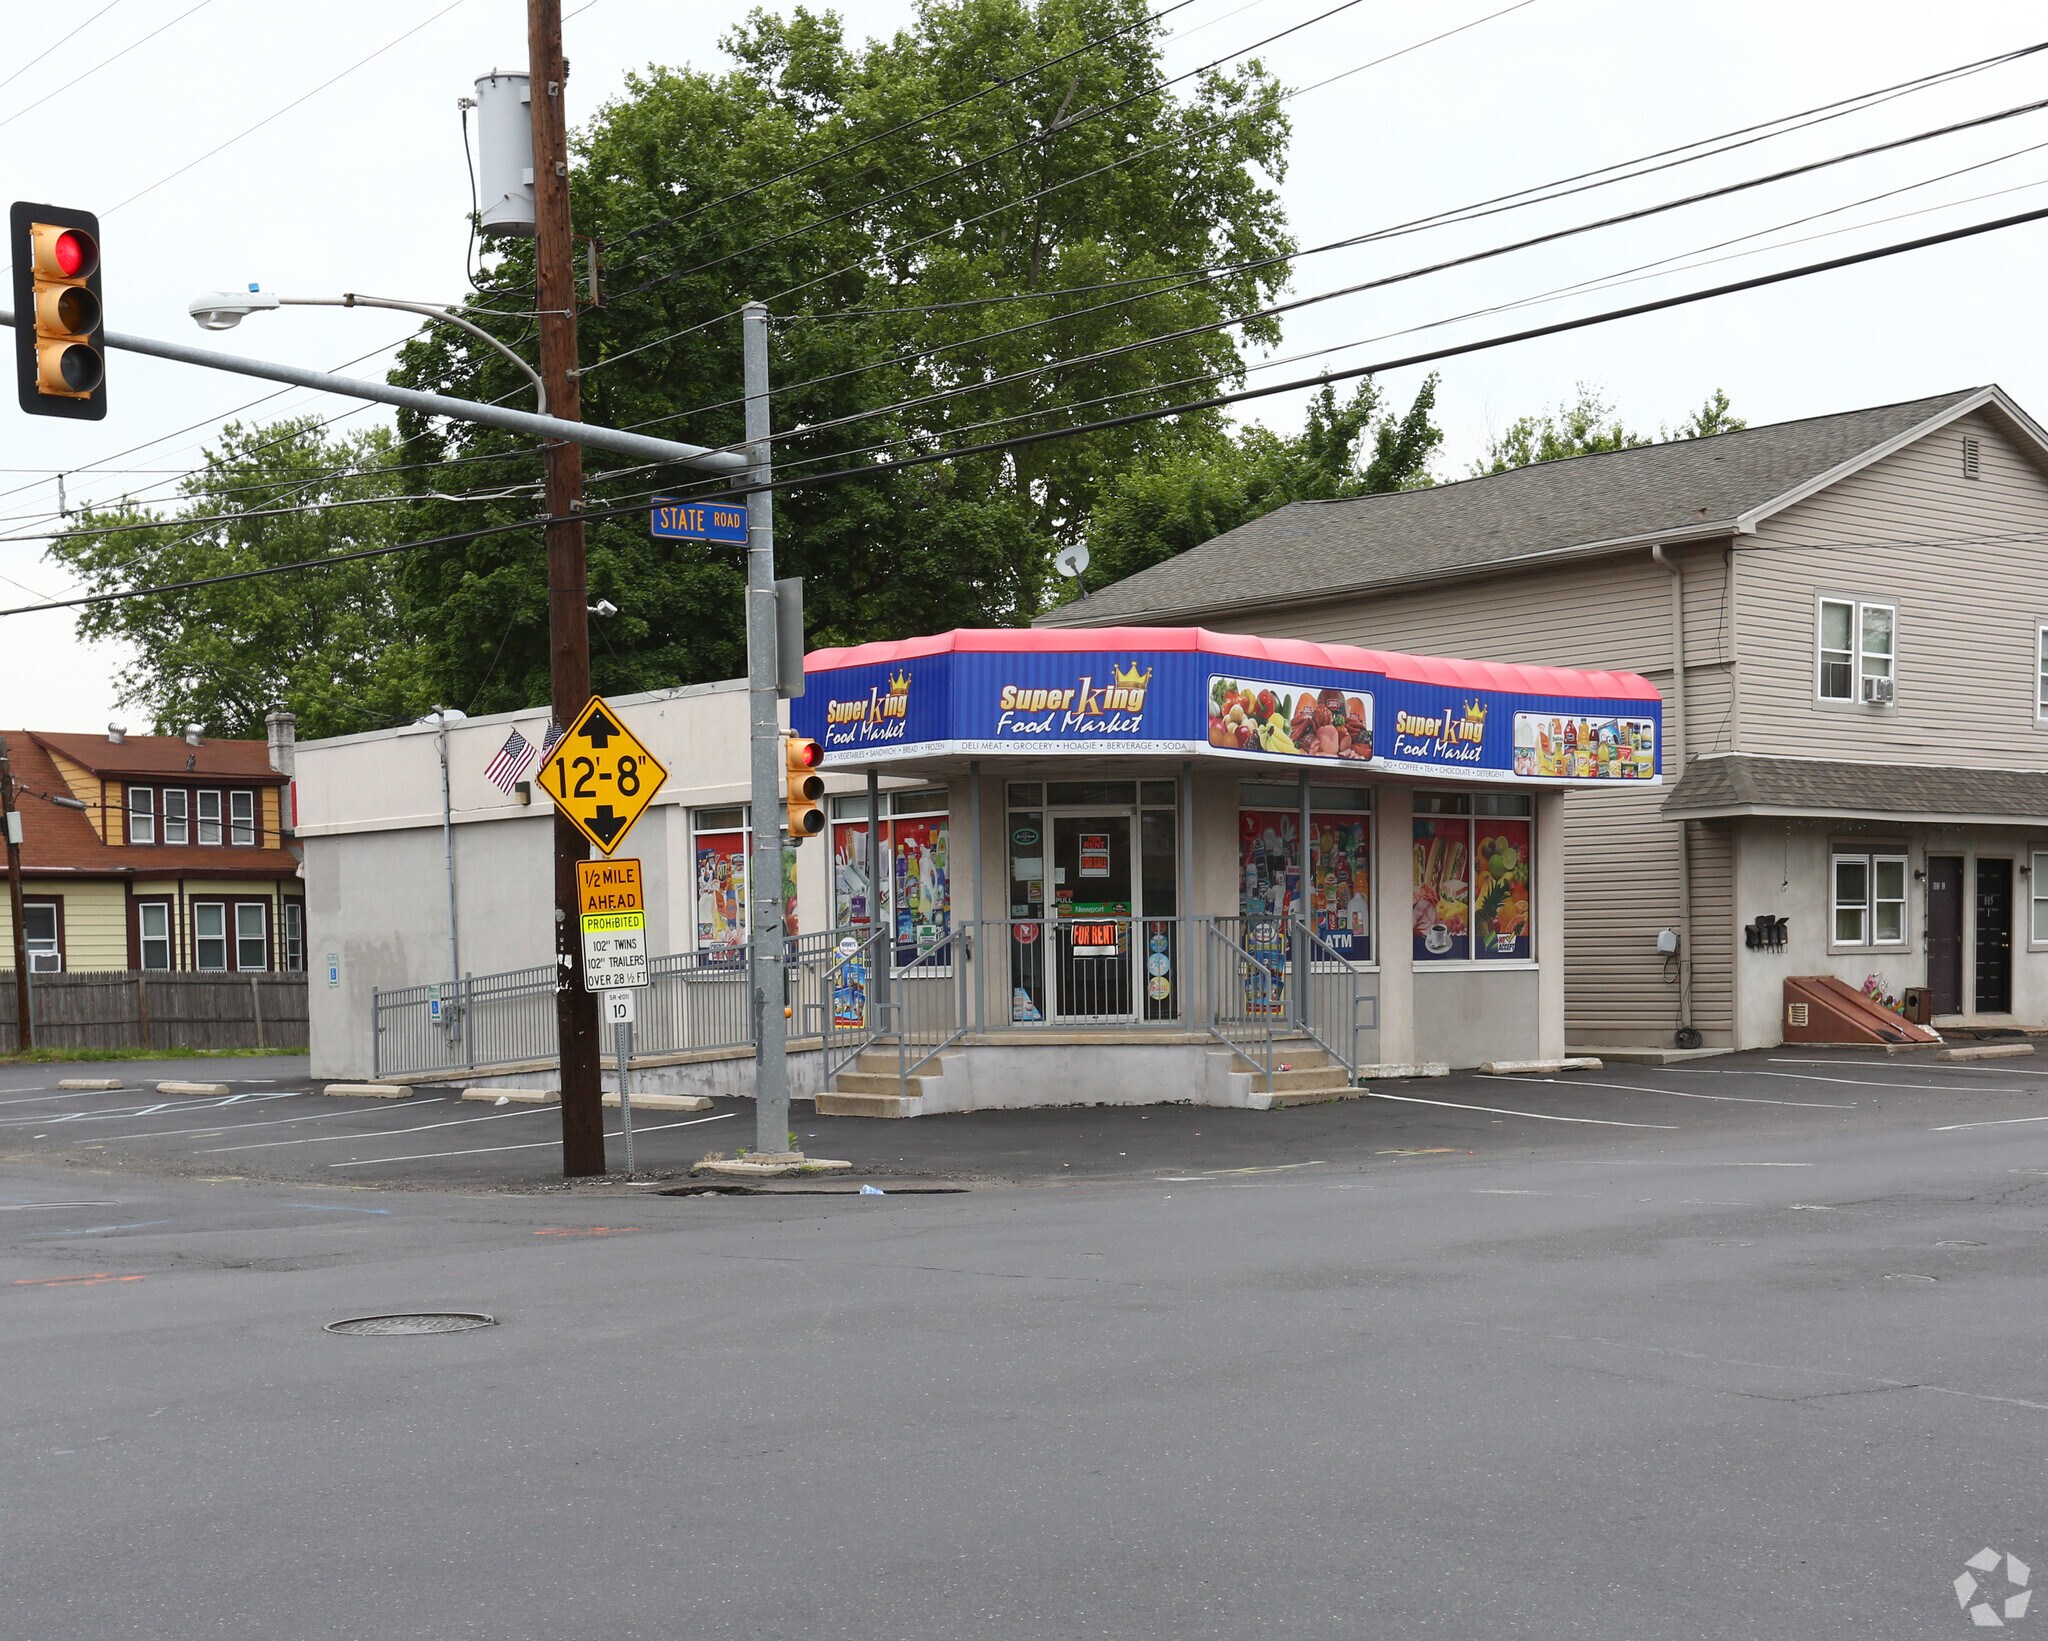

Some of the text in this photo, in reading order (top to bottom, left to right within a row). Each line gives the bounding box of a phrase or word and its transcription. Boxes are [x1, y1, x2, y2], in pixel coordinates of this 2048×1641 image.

[660, 507, 740, 532] STATE ROAD
[1000, 685, 1075, 712] Super
[827, 700, 869, 723] Super
[996, 710, 1144, 735] Food Market
[1396, 710, 1442, 737] Super
[825, 719, 907, 747] Food Market
[838, 750, 865, 760] VEGETABLES
[870, 748, 896, 758] SANDWICH
[902, 744, 918, 754] BREAD
[924, 742, 945, 751] FROZEN
[961, 741, 1187, 750] DELI MEAT GROCERY HOAGIE BERVERAGE SODA
[1393, 734, 1483, 762] Food Market
[556, 755, 646, 799] 12'-8"
[1398, 762, 1419, 772] COFFEE
[1424, 765, 1434, 773] TEA
[1440, 766, 1471, 776] CHOCOLATE
[1476, 769, 1505, 778] DETERGENT
[1084, 841, 1105, 849] RENT
[602, 868, 635, 884] MILE
[588, 893, 636, 910] AHEAD
[1075, 905, 1105, 914] Newport
[587, 916, 640, 930] PROHIBITED
[1074, 925, 1115, 945] FOR RENT
[1325, 934, 1352, 948] ATM
[614, 938, 637, 951] TWINS
[609, 954, 645, 968] TRAILERS
[588, 974, 612, 987] OVER
[614, 973, 625, 985] 28
[637, 971, 646, 983] FT
[613, 1003, 627, 1019] 10
